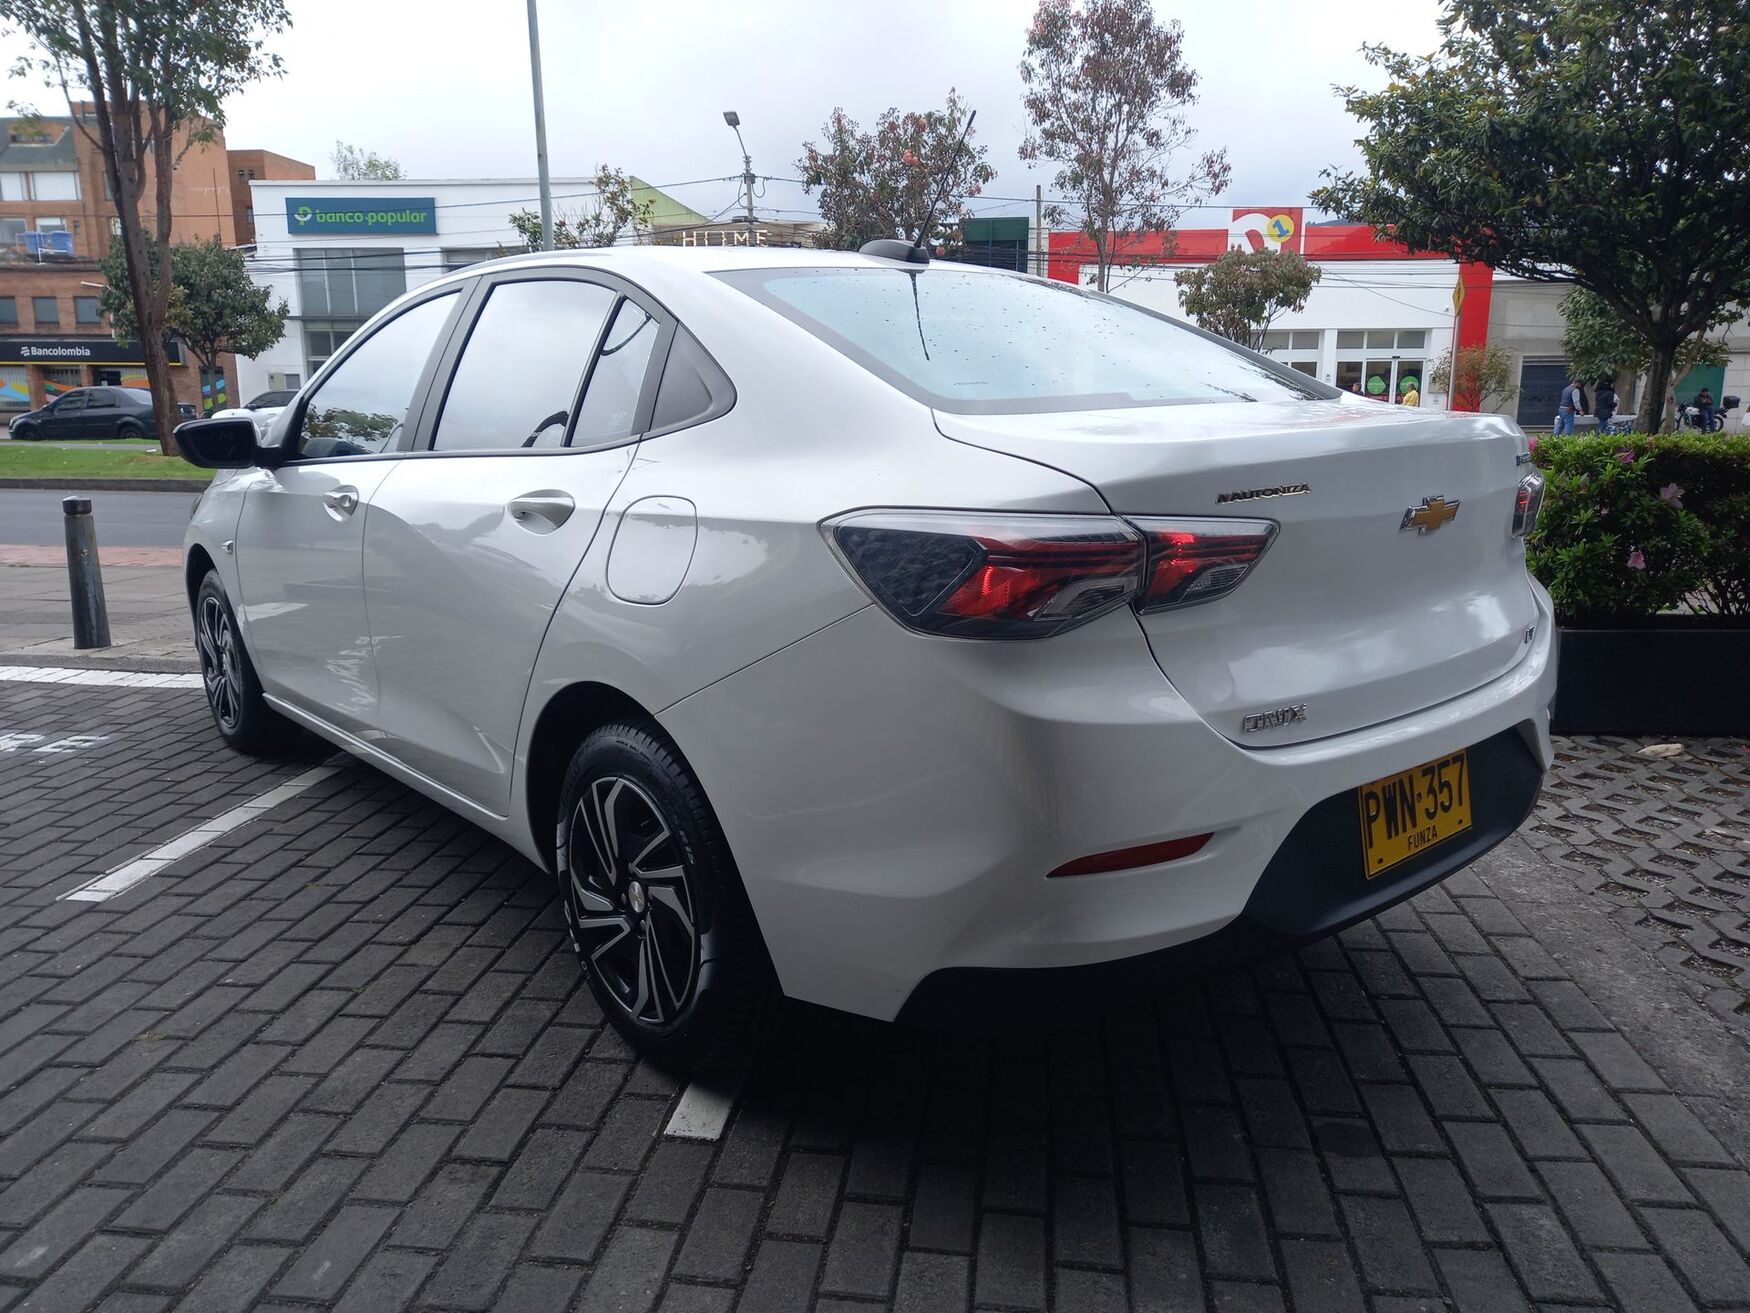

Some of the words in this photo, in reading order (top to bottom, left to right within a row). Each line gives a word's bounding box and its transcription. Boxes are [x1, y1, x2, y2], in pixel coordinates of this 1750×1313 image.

[316, 209, 363, 222] banco
[367, 210, 427, 226] popular
[682, 229, 769, 247] HOME
[30, 346, 91, 356] Bancolombia
[1242, 703, 1307, 733] ONIX
[1364, 774, 1418, 849] PWN
[1421, 754, 1465, 820] 357
[1407, 824, 1438, 851] FUNZA
